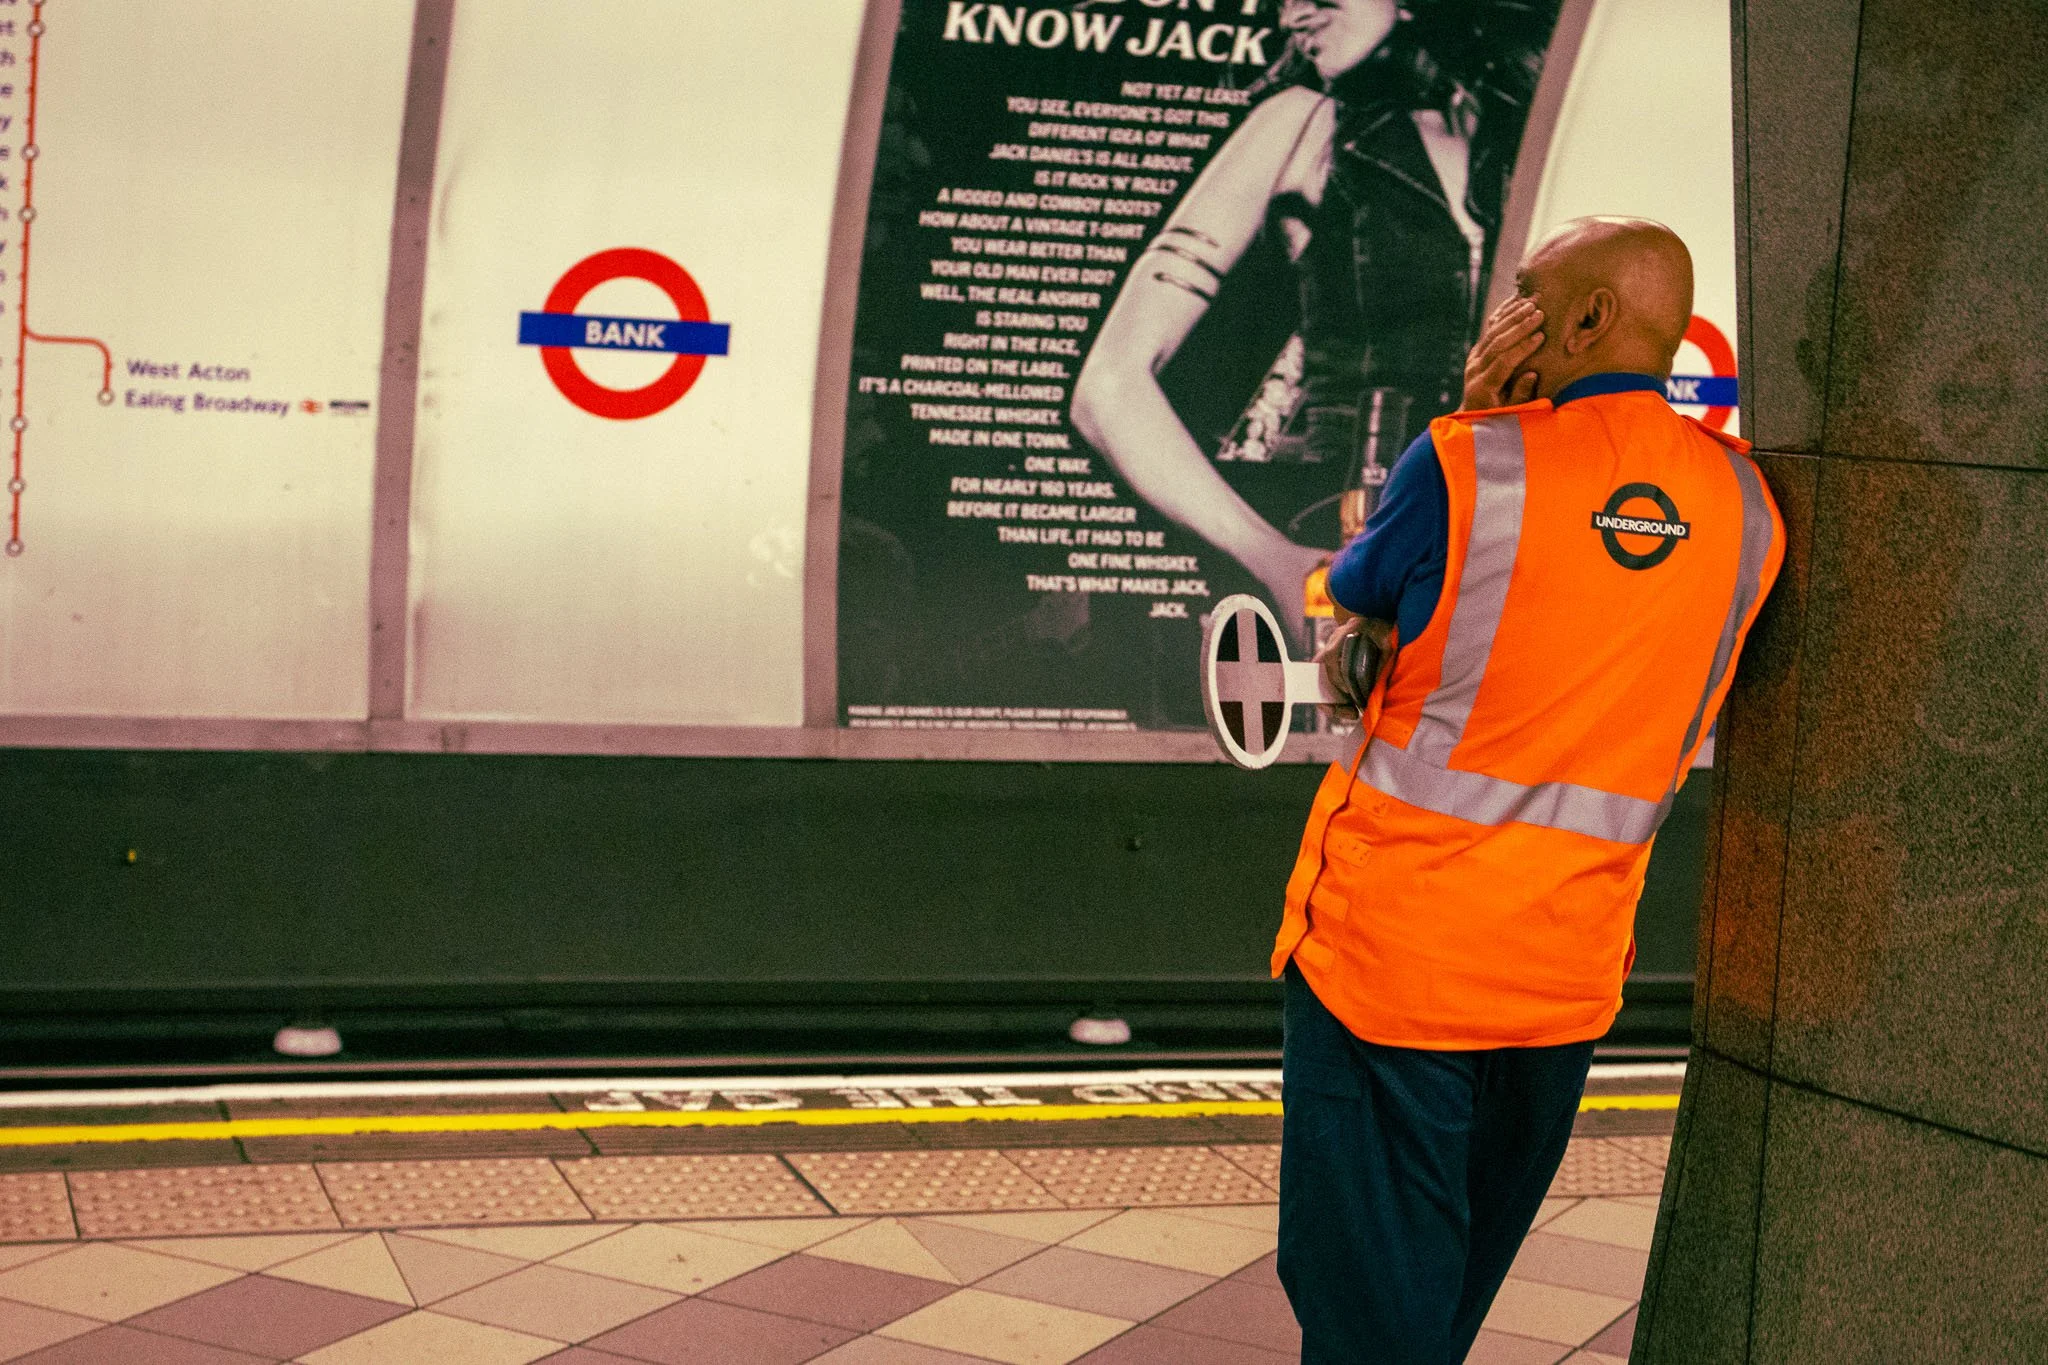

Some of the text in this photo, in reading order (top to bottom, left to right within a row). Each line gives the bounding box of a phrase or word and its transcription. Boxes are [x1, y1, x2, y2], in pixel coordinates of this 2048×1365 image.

[943, 2, 1272, 66] KNOW JACK
[1120, 81, 1152, 97] NOT
[1155, 83, 1183, 100] YET
[1183, 86, 1203, 101] AT
[1007, 96, 1039, 113] YOU
[1072, 101, 1162, 122] EVERYONE'S
[1163, 108, 1195, 124] GOT
[1196, 110, 1230, 128] THIS
[1028, 122, 1211, 149] DIFFERENT IDEA OF WHAT
[989, 143, 1028, 160] JACK
[1029, 146, 1093, 166] DANIEL'S
[1095, 150, 1112, 166] IS
[1112, 152, 1139, 168] ALL
[1034, 170, 1050, 186] IS
[1050, 171, 1067, 187] IT
[1067, 172, 1109, 189] ROCK
[1131, 177, 1178, 195] ROLL?
[937, 188, 950, 203] A
[1004, 193, 1038, 209] AND
[1039, 195, 1102, 213] COWBOY
[1103, 199, 1162, 217] BOOTS?
[919, 210, 1146, 239] HOW ABOUT A VINTAGE T-SHIRT
[951, 236, 1127, 262] YOU WEAR BETTER THAN
[930, 259, 1116, 286] YOUR OLD MAN EVER DID?
[968, 285, 997, 303] THE
[997, 287, 1035, 305] REAL
[1036, 289, 1101, 308] ANSWER
[975, 310, 1089, 332] IS STARING YOU
[586, 321, 665, 347] BANK
[943, 332, 989, 350] RIGHT
[990, 335, 1009, 351] IN
[1010, 336, 1039, 354] THE
[126, 358, 251, 382] West Acton
[901, 354, 965, 373] PRINTED
[965, 357, 990, 375] ON
[991, 359, 1020, 376] THE
[858, 376, 1065, 402] IT'S A CHARCOAL-MELLOWED
[1665, 380, 1700, 401] NK
[124, 388, 290, 418] Ealing Broadway
[910, 402, 993, 423] TENNESSEE
[929, 428, 972, 446] MADE
[972, 430, 991, 446] IN
[991, 431, 1023, 448] ONE
[1024, 456, 1056, 473] ONE
[950, 476, 982, 494] FOR
[982, 478, 1038, 496] NEARLY
[947, 500, 1137, 523] BEFORE IT BECAME LARGER
[997, 525, 1040, 543] THAN
[1075, 529, 1091, 545] IT
[1091, 529, 1123, 547] HAD
[1124, 530, 1145, 547] TO
[1145, 531, 1165, 548] BE
[1595, 515, 1686, 536] UNDERGROUND
[1067, 552, 1099, 570] ONE
[1100, 553, 1133, 571] FINE
[1026, 574, 1077, 593] THAT'S
[1077, 576, 1120, 593] WHAT
[1120, 577, 1169, 595] MAKES
[583, 1087, 802, 1113] GAP
[835, 1083, 1042, 1108] THE
